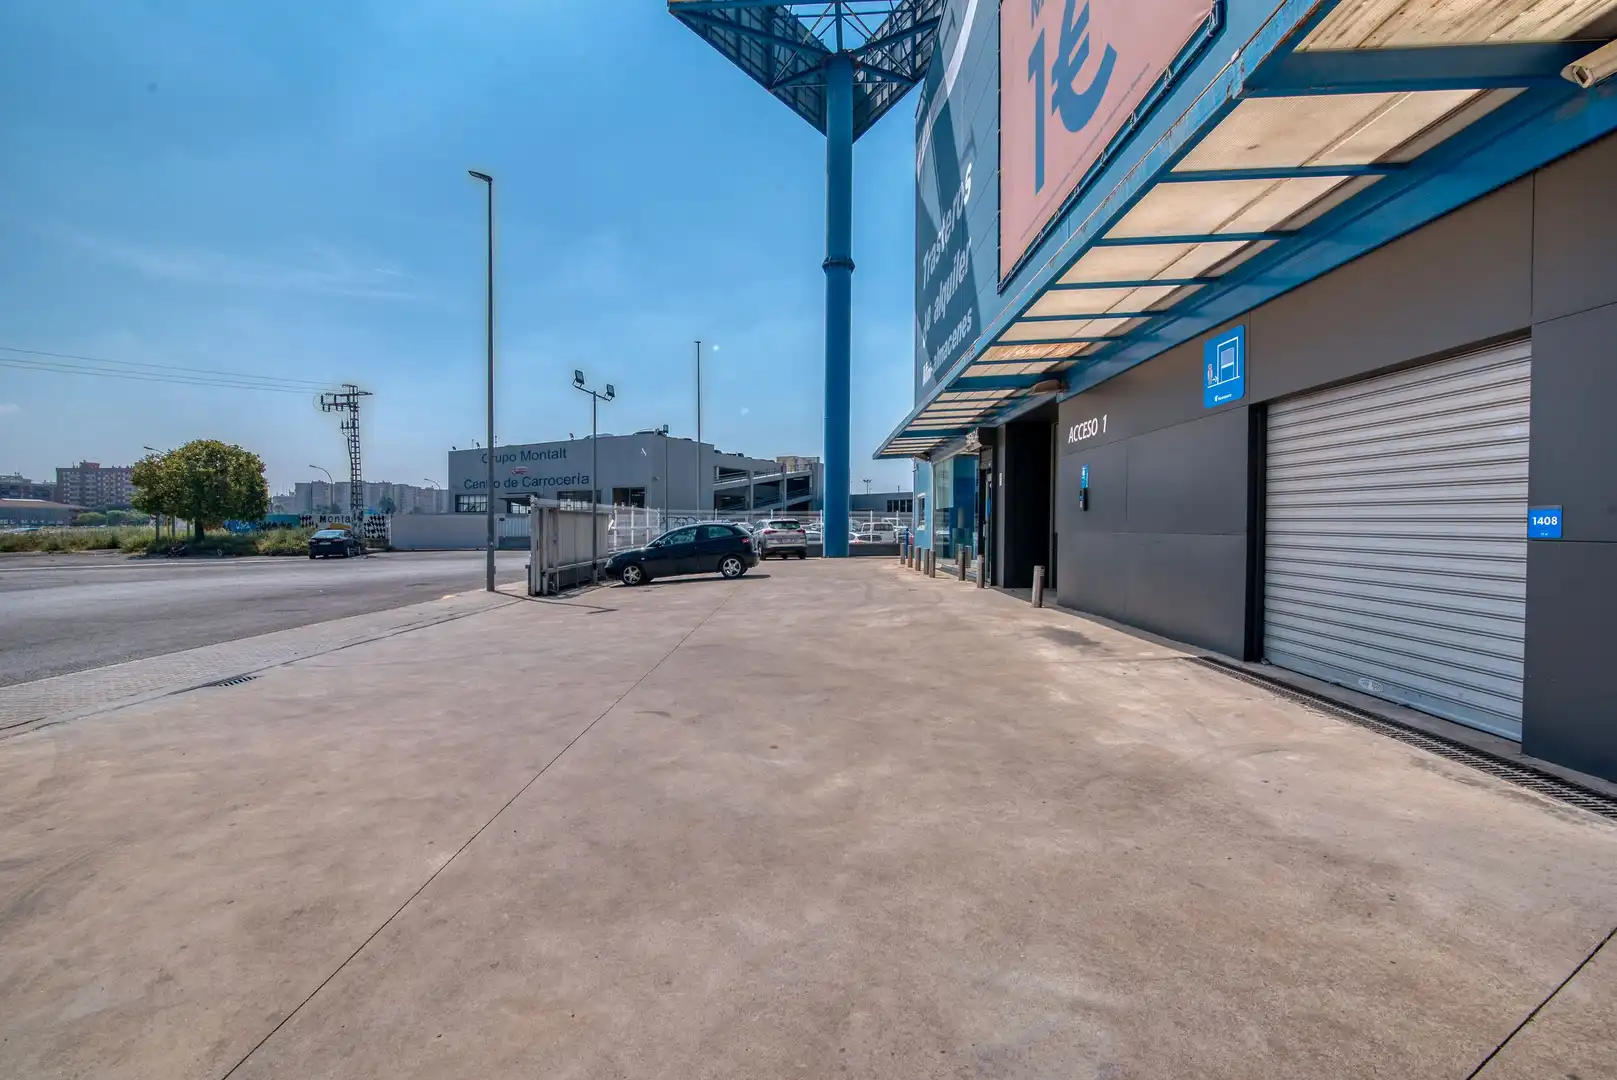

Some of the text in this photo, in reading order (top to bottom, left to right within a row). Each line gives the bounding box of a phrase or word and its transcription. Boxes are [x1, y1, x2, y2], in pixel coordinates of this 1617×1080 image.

[923, 162, 972, 290] Trasteros
[922, 236, 972, 348] de alquiler
[1068, 414, 1108, 444] ACCESO 1
[481, 447, 567, 465] Gupo Montalt
[464, 472, 590, 490] Ceno de Carrocería
[1532, 516, 1558, 526] 1408
